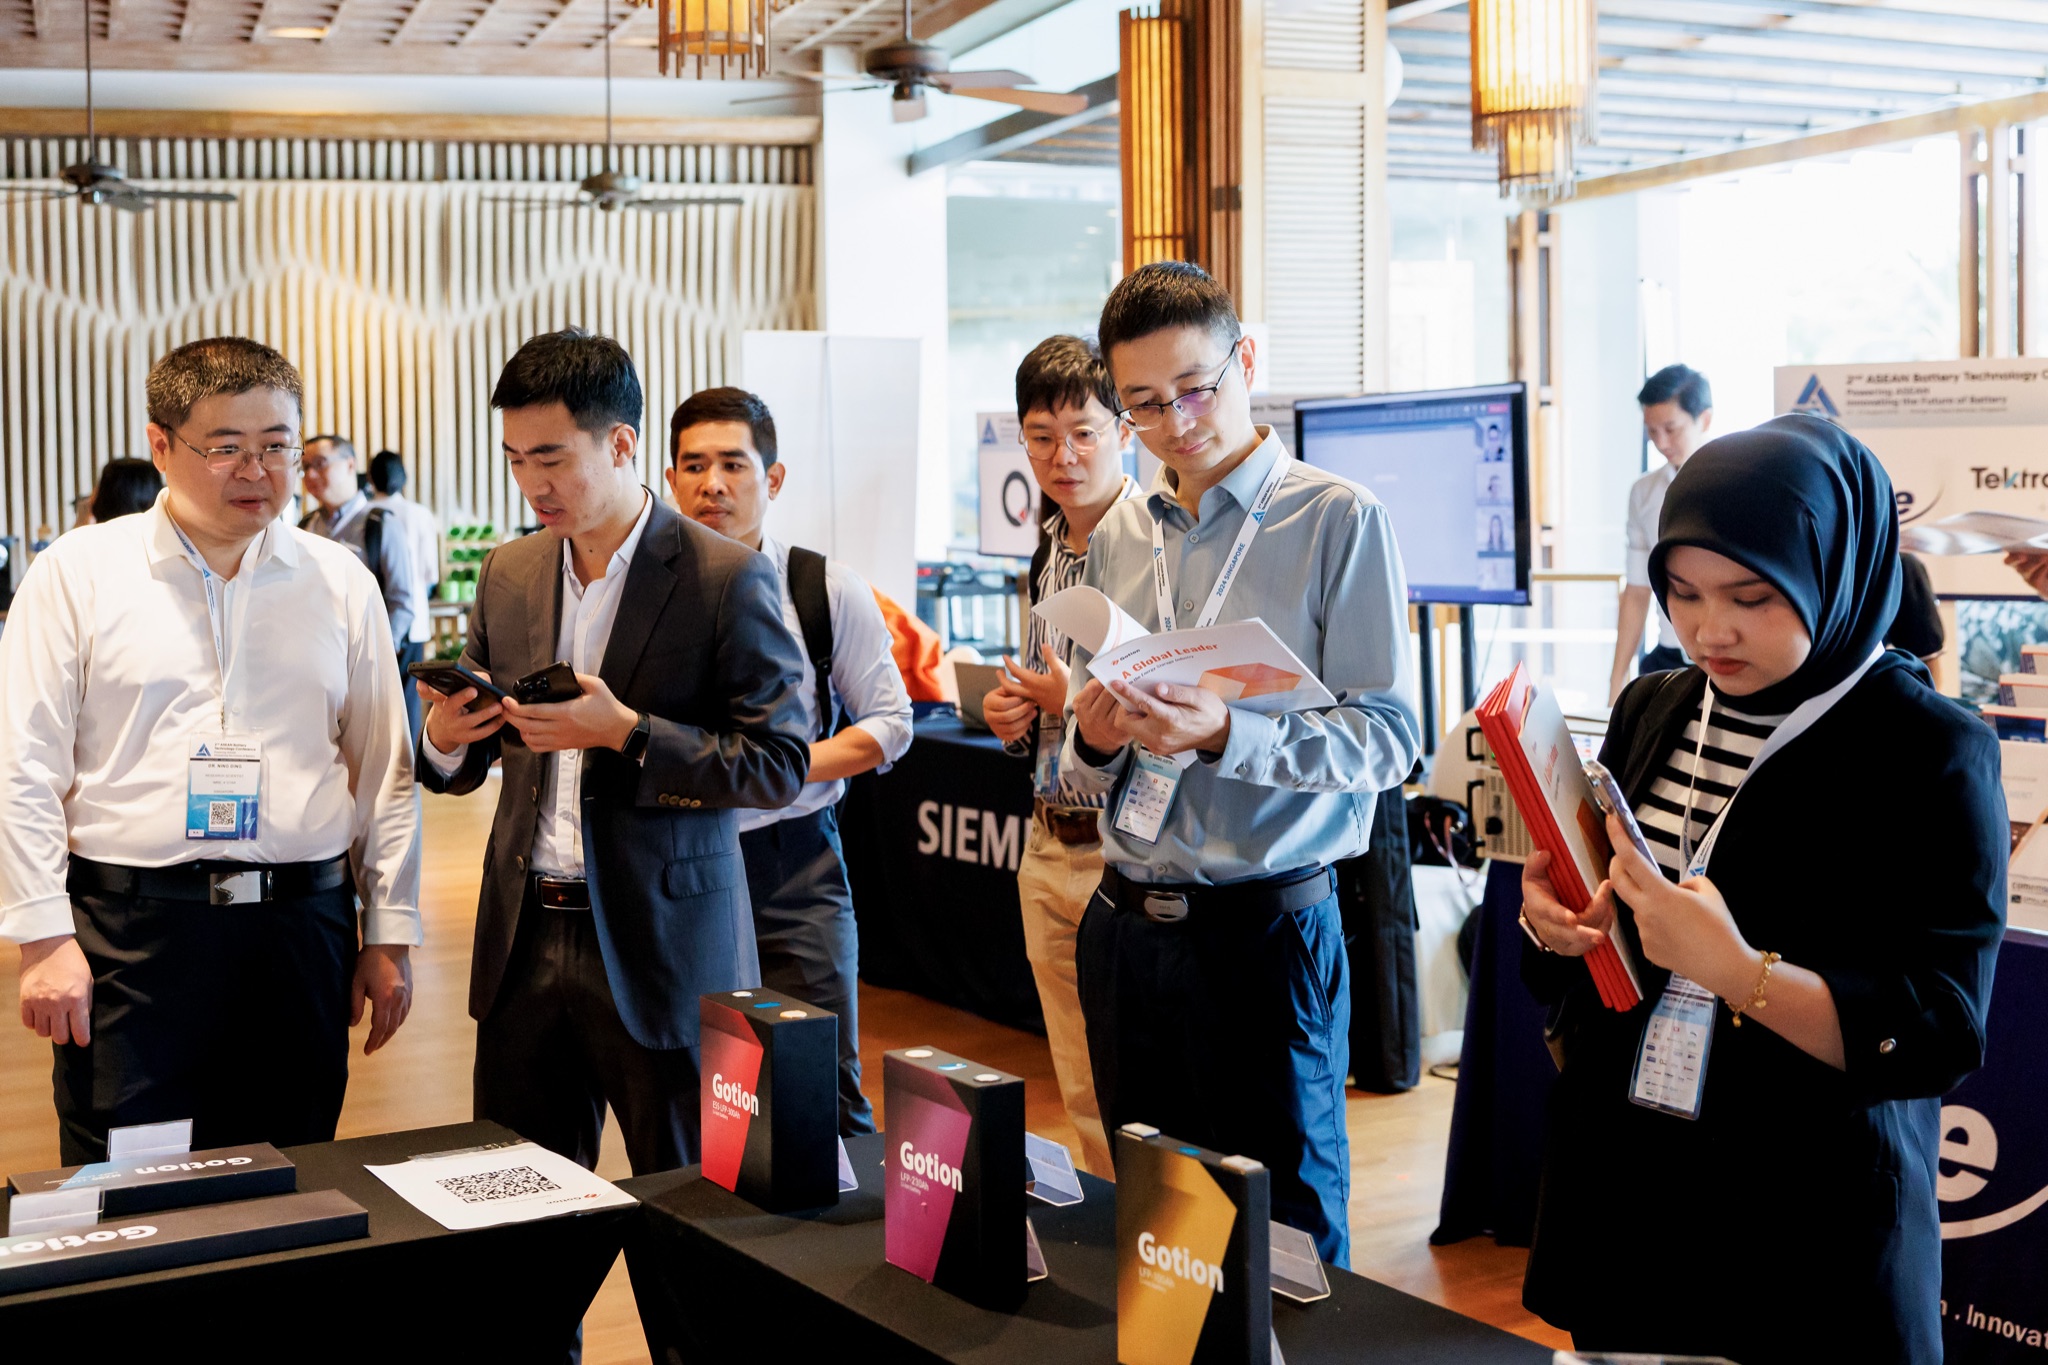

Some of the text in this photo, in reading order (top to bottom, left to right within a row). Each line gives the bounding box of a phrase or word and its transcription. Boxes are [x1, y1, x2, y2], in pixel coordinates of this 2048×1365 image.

[1866, 373, 1910, 384] ASEAN
[1913, 372, 1959, 385] Battery
[1963, 370, 2037, 383] Technology
[1216, 542, 1246, 597] 2024 SINGAPORE
[1120, 649, 1141, 661] Gotion
[1121, 643, 1218, 680] A Global Leader
[918, 800, 1032, 871] SIEM
[712, 1073, 759, 1116] Gotion
[135, 1157, 253, 1174] Gotion
[900, 1141, 963, 1193] Gotion
[1138, 1231, 1224, 1294] Gotion
